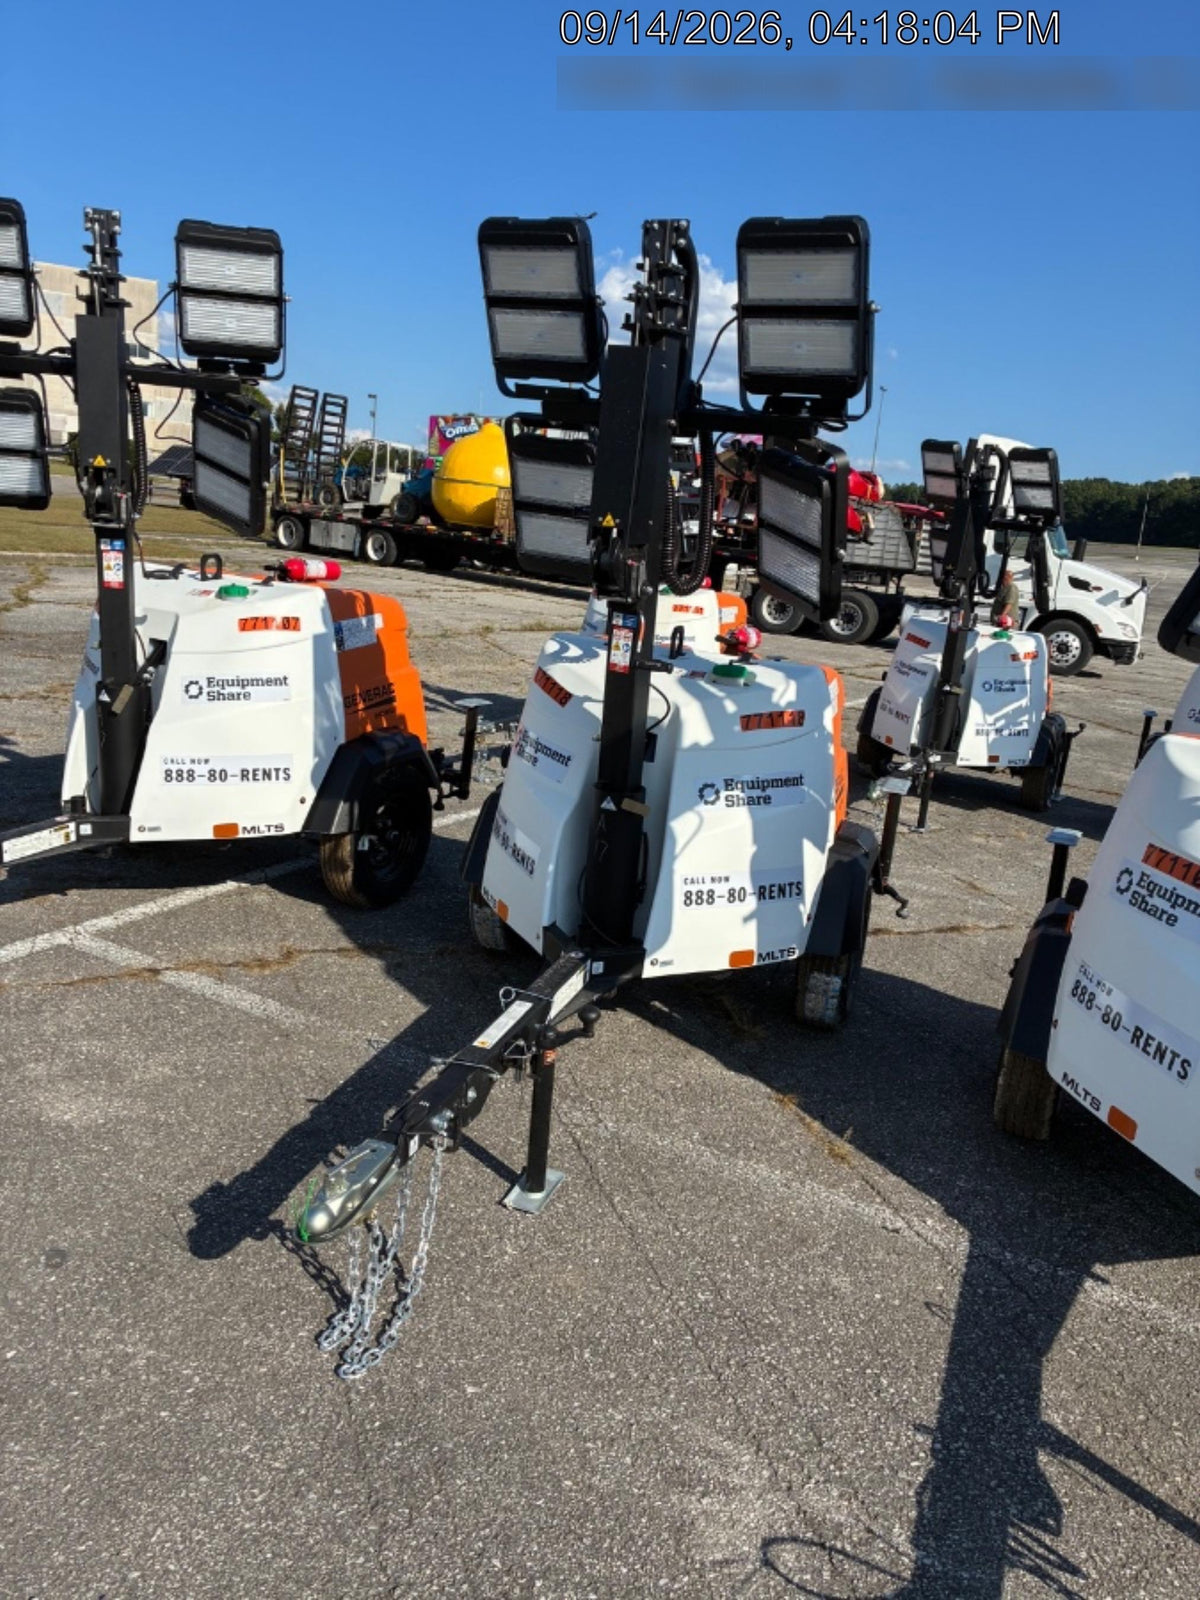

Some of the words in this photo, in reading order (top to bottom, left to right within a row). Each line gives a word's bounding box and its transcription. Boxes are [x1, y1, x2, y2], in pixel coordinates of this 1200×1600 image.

[206, 675, 289, 689] Equipment
[207, 690, 251, 701] Share
[163, 757, 186, 765] CALL
[164, 767, 291, 783] 888-80-RENTS
[723, 773, 805, 793] Equipment
[725, 794, 772, 807] Share
[242, 822, 285, 835] MLTS
[684, 876, 706, 885] CALL
[711, 876, 730, 884] NOW
[683, 881, 803, 907] 888-80-RENTS
[1128, 889, 1179, 927] Share
[757, 946, 797, 963] MLTS
[1079, 964, 1095, 984] CALL
[1095, 978, 1115, 997] NOW
[1071, 978, 1192, 1081] 888-80-RENTS
[1061, 1071, 1103, 1112] MLTS
